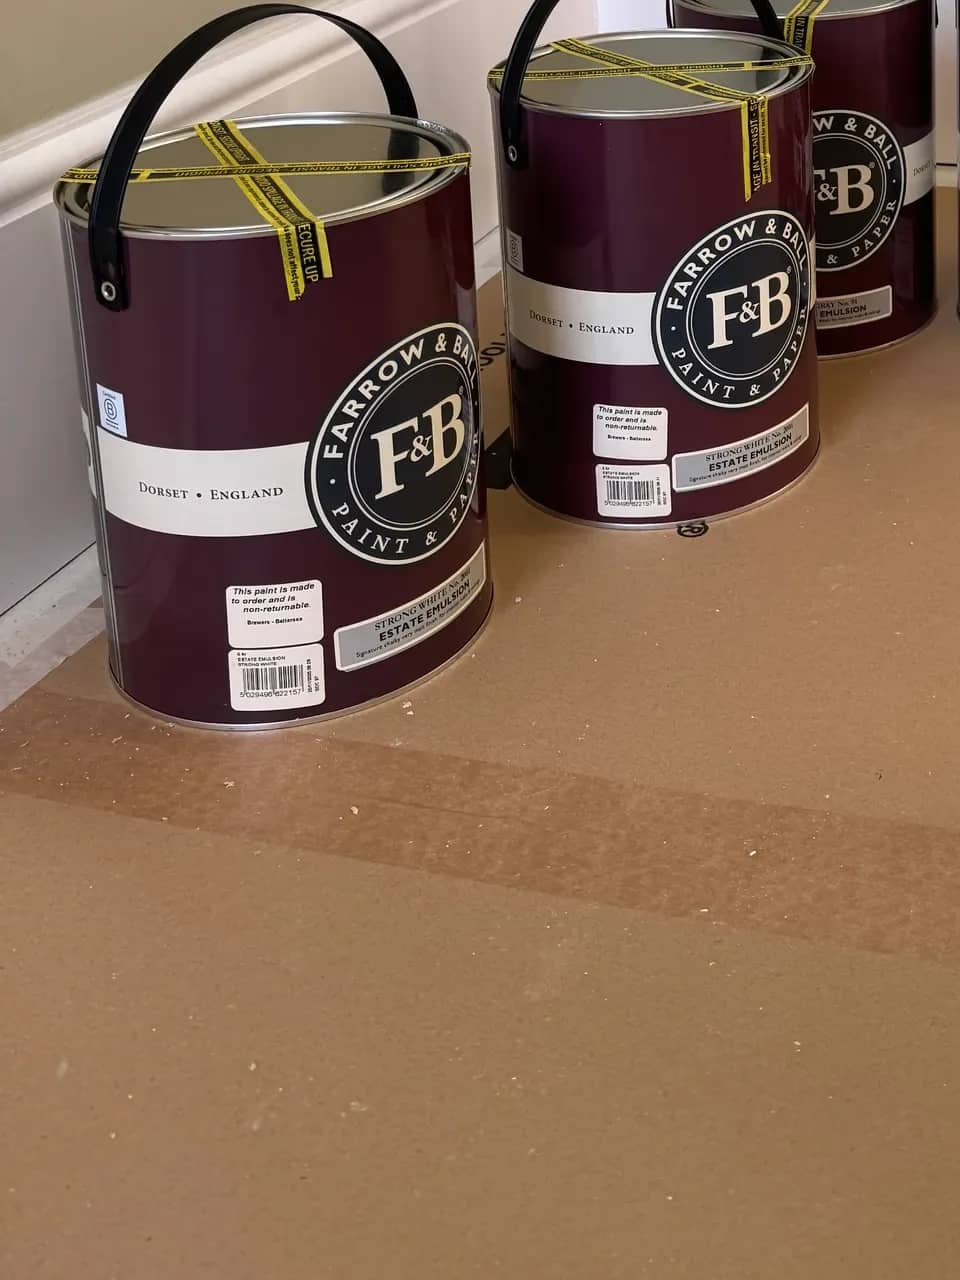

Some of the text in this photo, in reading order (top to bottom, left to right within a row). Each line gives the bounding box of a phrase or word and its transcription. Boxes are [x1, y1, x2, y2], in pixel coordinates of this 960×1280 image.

[750, 118, 760, 160] TRANSIT
[844, 117, 857, 132] &
[864, 124, 898, 170] BALL
[298, 223, 319, 282] ECURE UP
[826, 199, 897, 265] & PAPER
[667, 218, 807, 310] FARROW & BALL
[529, 310, 634, 335] DORSET ENGLAND
[706, 271, 792, 350] F&B
[819, 304, 867, 318] EMULSION
[672, 307, 806, 399] PAINT & PAPER
[323, 338, 425, 459] FARROW
[434, 332, 447, 353] &
[453, 333, 477, 389] BALL
[599, 406, 613, 414] This
[614, 408, 633, 416] paint
[605, 415, 623, 423] order
[370, 392, 465, 500] F&B
[705, 446, 743, 462] STRONG
[744, 435, 771, 451] WHITE
[709, 454, 748, 472] ESTATE
[750, 432, 792, 460] EMULSION
[139, 481, 284, 500] DORSET ENGLAND
[331, 431, 479, 554] PAINT & PAPER
[233, 583, 315, 596] This paint is made
[243, 601, 311, 613] non-returnable.
[268, 595, 285, 603] and
[374, 607, 417, 631] STRONG
[418, 588, 448, 610] WHITE
[379, 614, 424, 641] ESTATE
[426, 579, 470, 618] EMULSION
